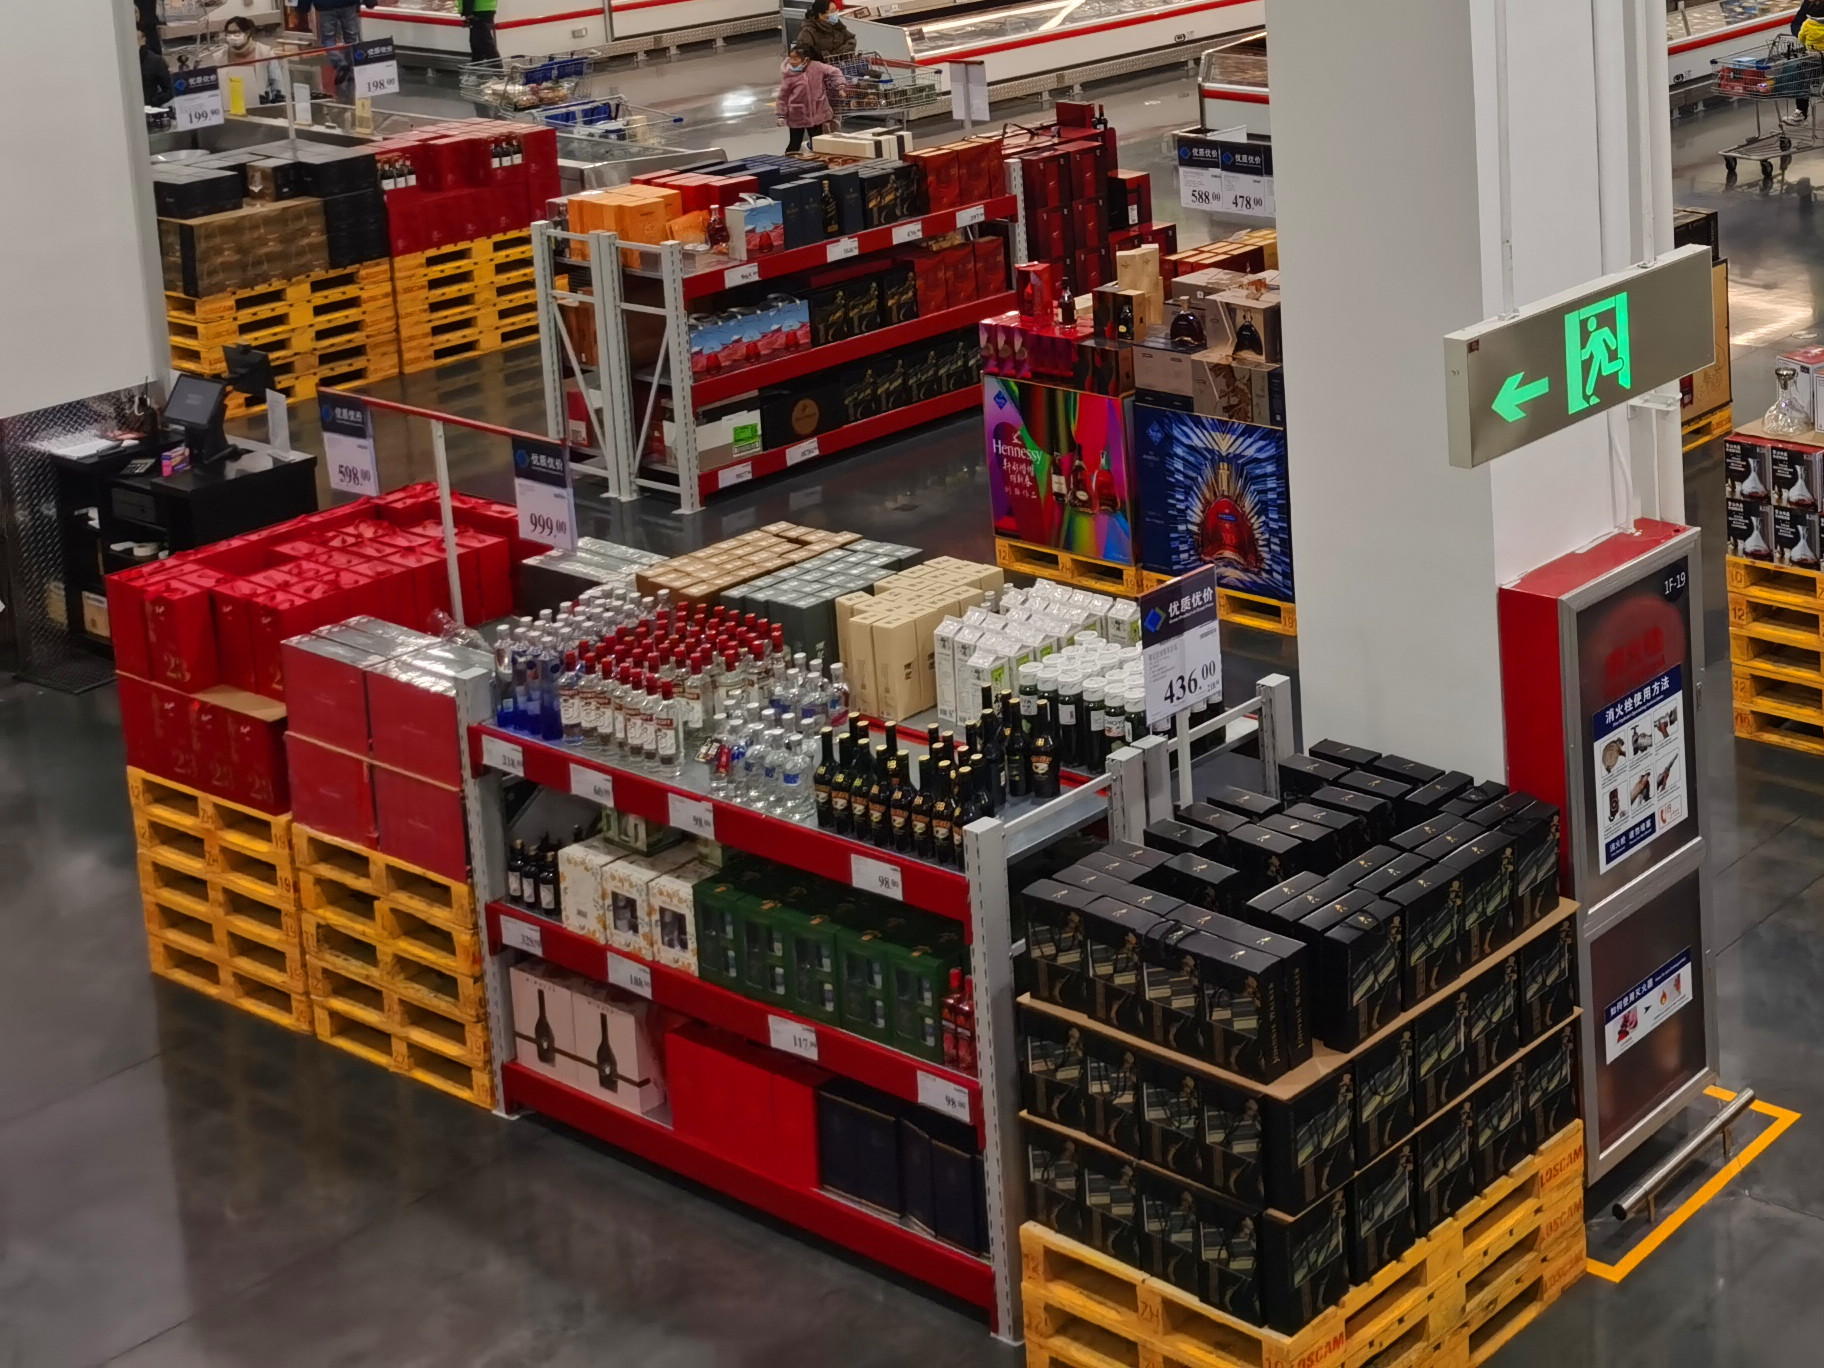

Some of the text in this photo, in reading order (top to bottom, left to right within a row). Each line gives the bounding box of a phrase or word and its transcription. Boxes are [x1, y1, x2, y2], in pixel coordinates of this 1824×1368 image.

[187, 107, 220, 124] 199.90
[1191, 189, 1220, 205] 588.00
[1232, 194, 1262, 210] 478.00
[993, 438, 1043, 464] Hennessy
[337, 463, 371, 486] 598.00
[529, 512, 566, 537] 999.00
[1664, 571, 1686, 595] 1F-19
[1168, 586, 1214, 618] 优质优价
[1731, 606, 1746, 621] 12
[1163, 660, 1216, 705] 436.00
[1605, 675, 1670, 724] 消火栓使用方法
[1539, 1144, 1584, 1188] LOSCAM
